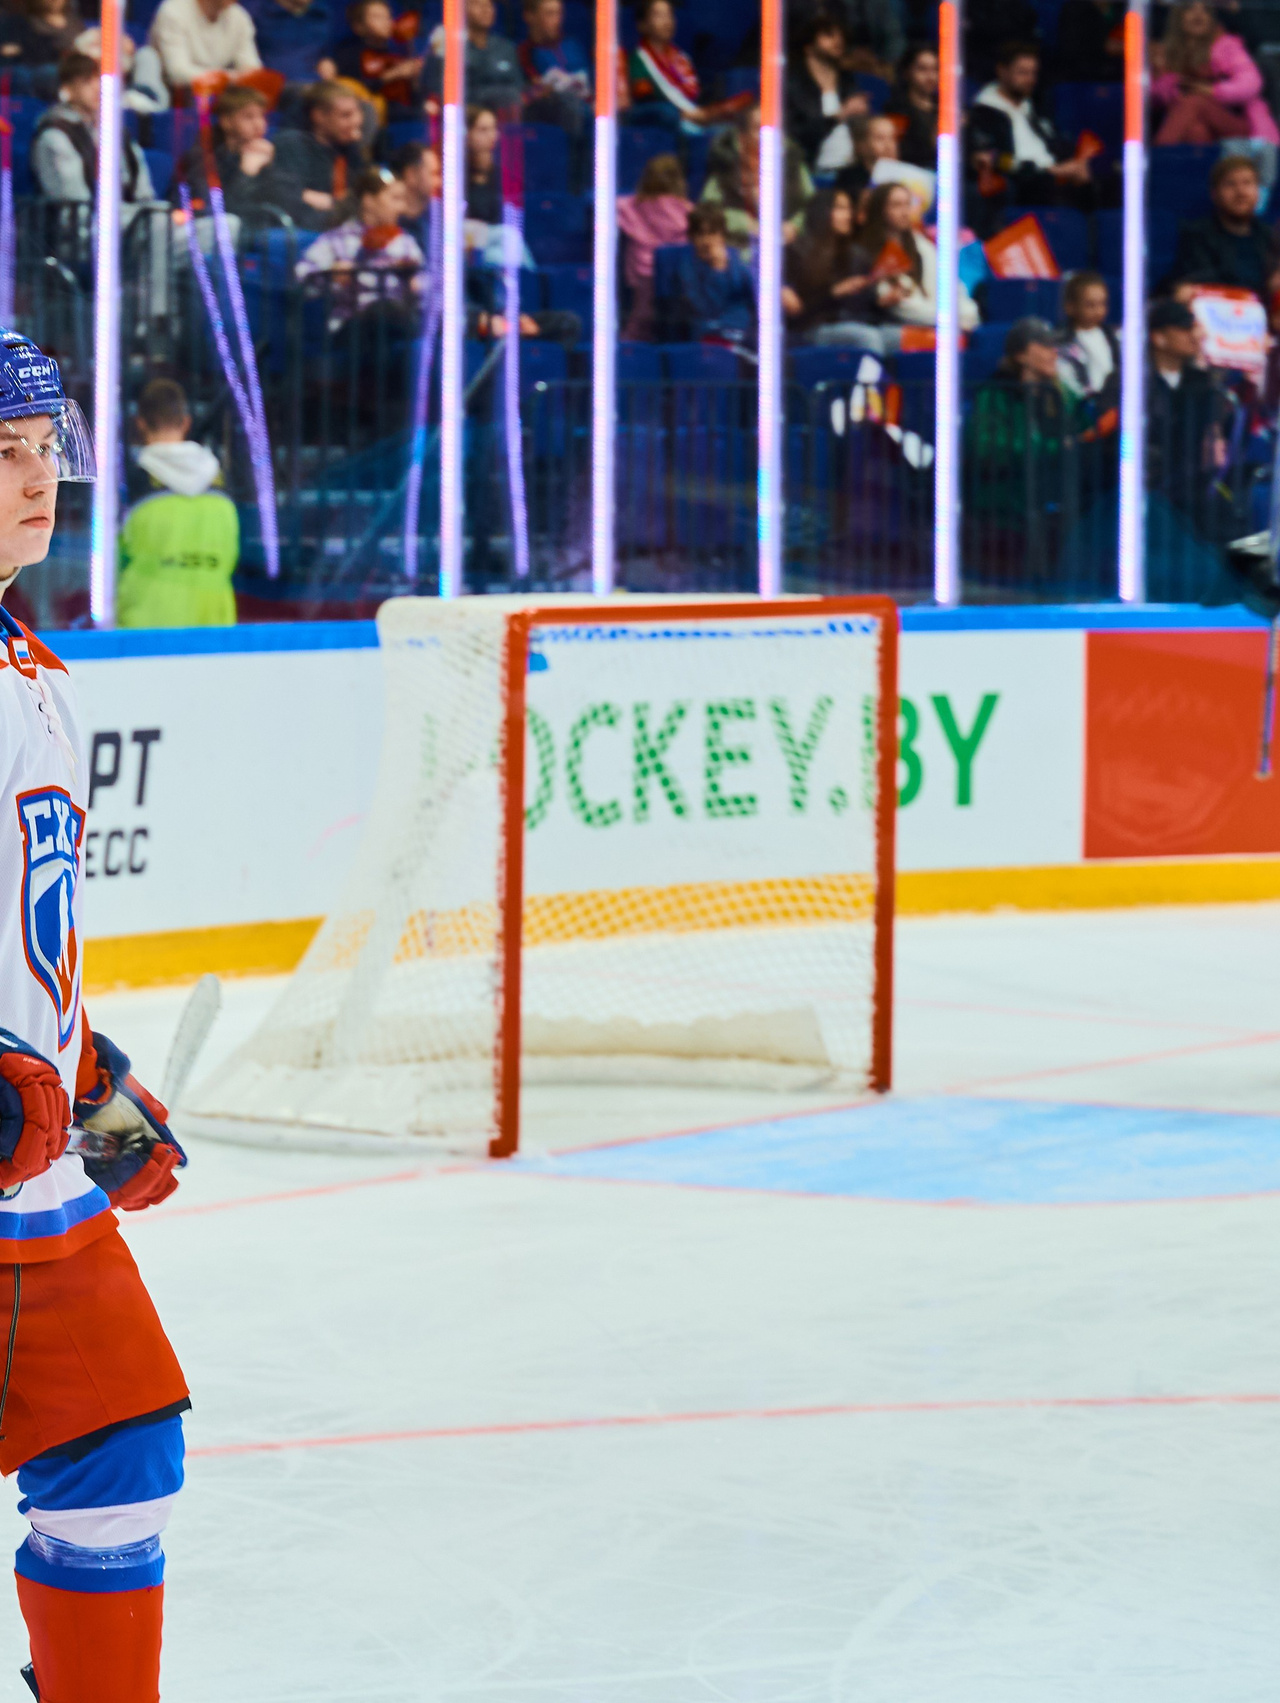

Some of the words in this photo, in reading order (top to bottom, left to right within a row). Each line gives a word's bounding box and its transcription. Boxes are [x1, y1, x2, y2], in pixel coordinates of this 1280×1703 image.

[18, 366, 51, 378] CCM
[87, 729, 162, 809] РТ
[422, 694, 1000, 830] OCKEY.BY
[85, 828, 148, 878] ЕСС
